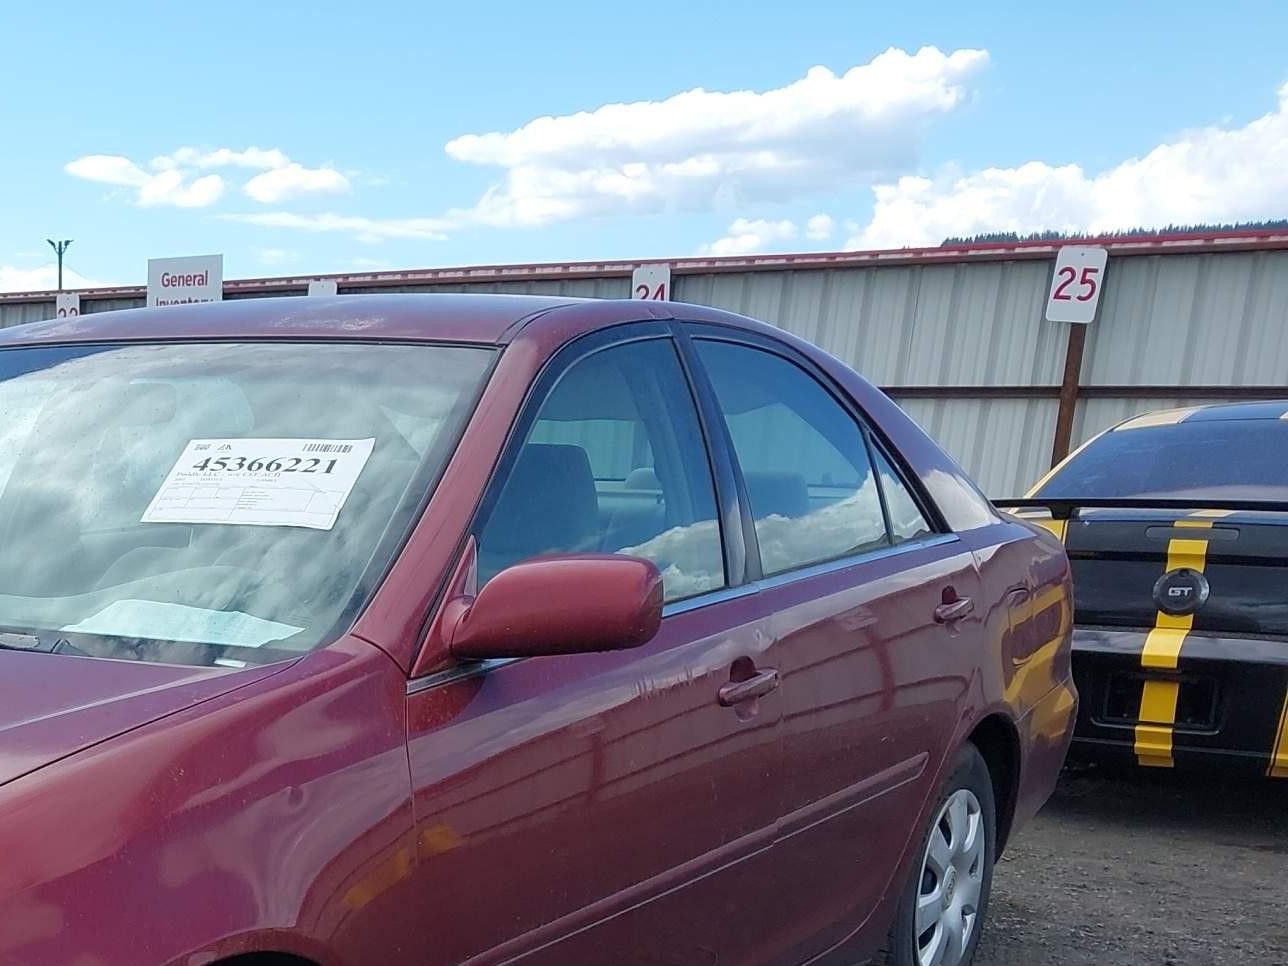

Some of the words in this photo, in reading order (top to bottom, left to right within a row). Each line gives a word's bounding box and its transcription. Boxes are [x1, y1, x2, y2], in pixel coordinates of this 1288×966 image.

[161, 269, 208, 287] General
[1053, 266, 1099, 301] 25
[192, 456, 338, 474] 45366221
[1168, 587, 1192, 596] GT
